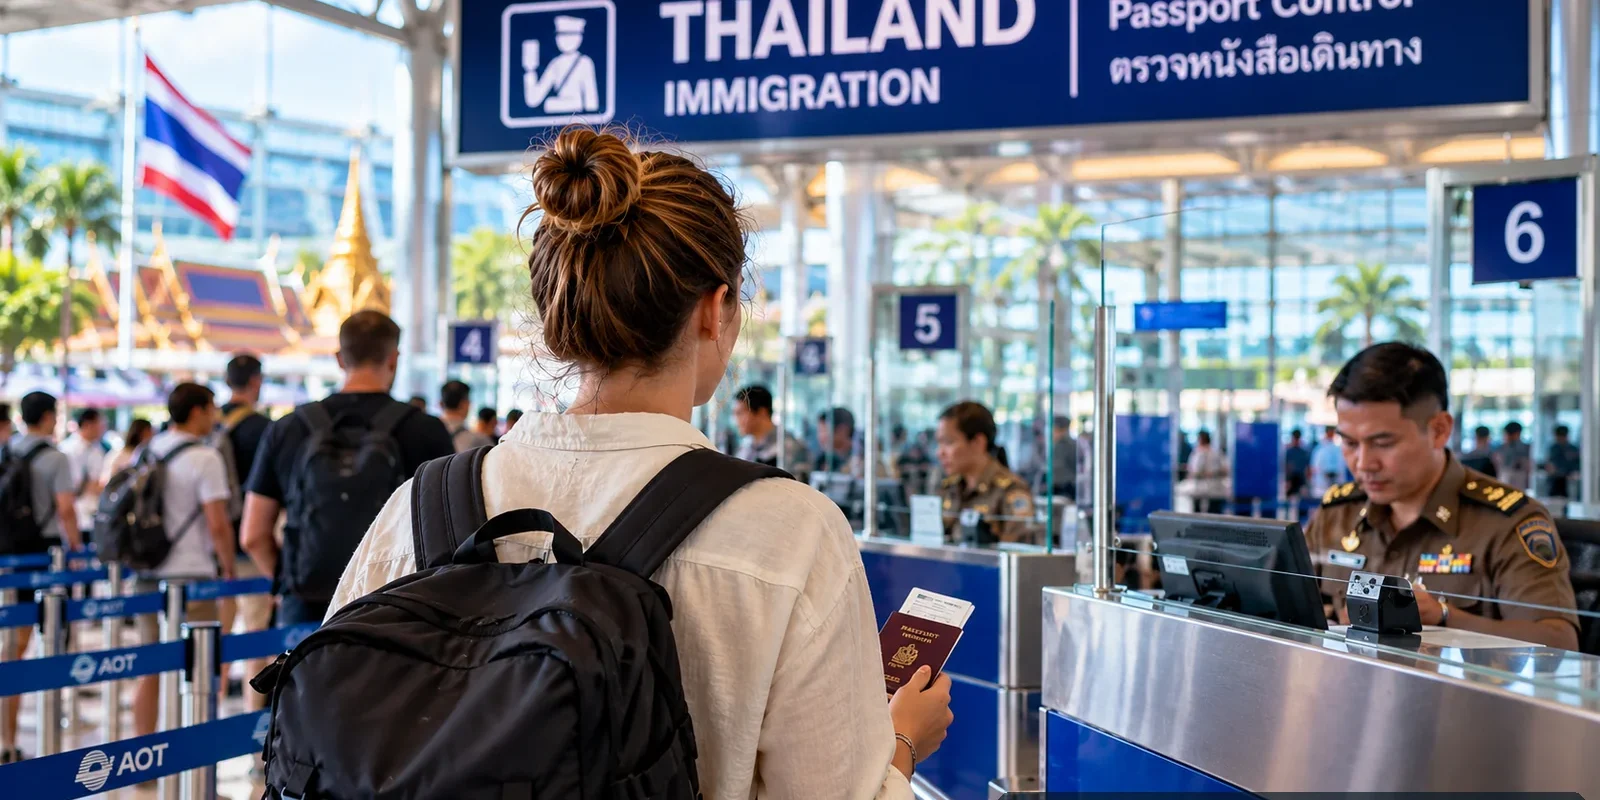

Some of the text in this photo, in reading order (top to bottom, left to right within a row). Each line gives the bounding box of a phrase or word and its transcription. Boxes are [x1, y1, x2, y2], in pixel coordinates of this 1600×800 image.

[659, 0, 1036, 63] THAILAND
[1109, 0, 1262, 33] Passport
[664, 66, 941, 117] IMMIGRATION
[1504, 200, 1545, 264] 6
[914, 303, 942, 344] 5
[460, 329, 484, 361] 4
[98, 653, 138, 675] AOT
[116, 742, 169, 776] AOT
